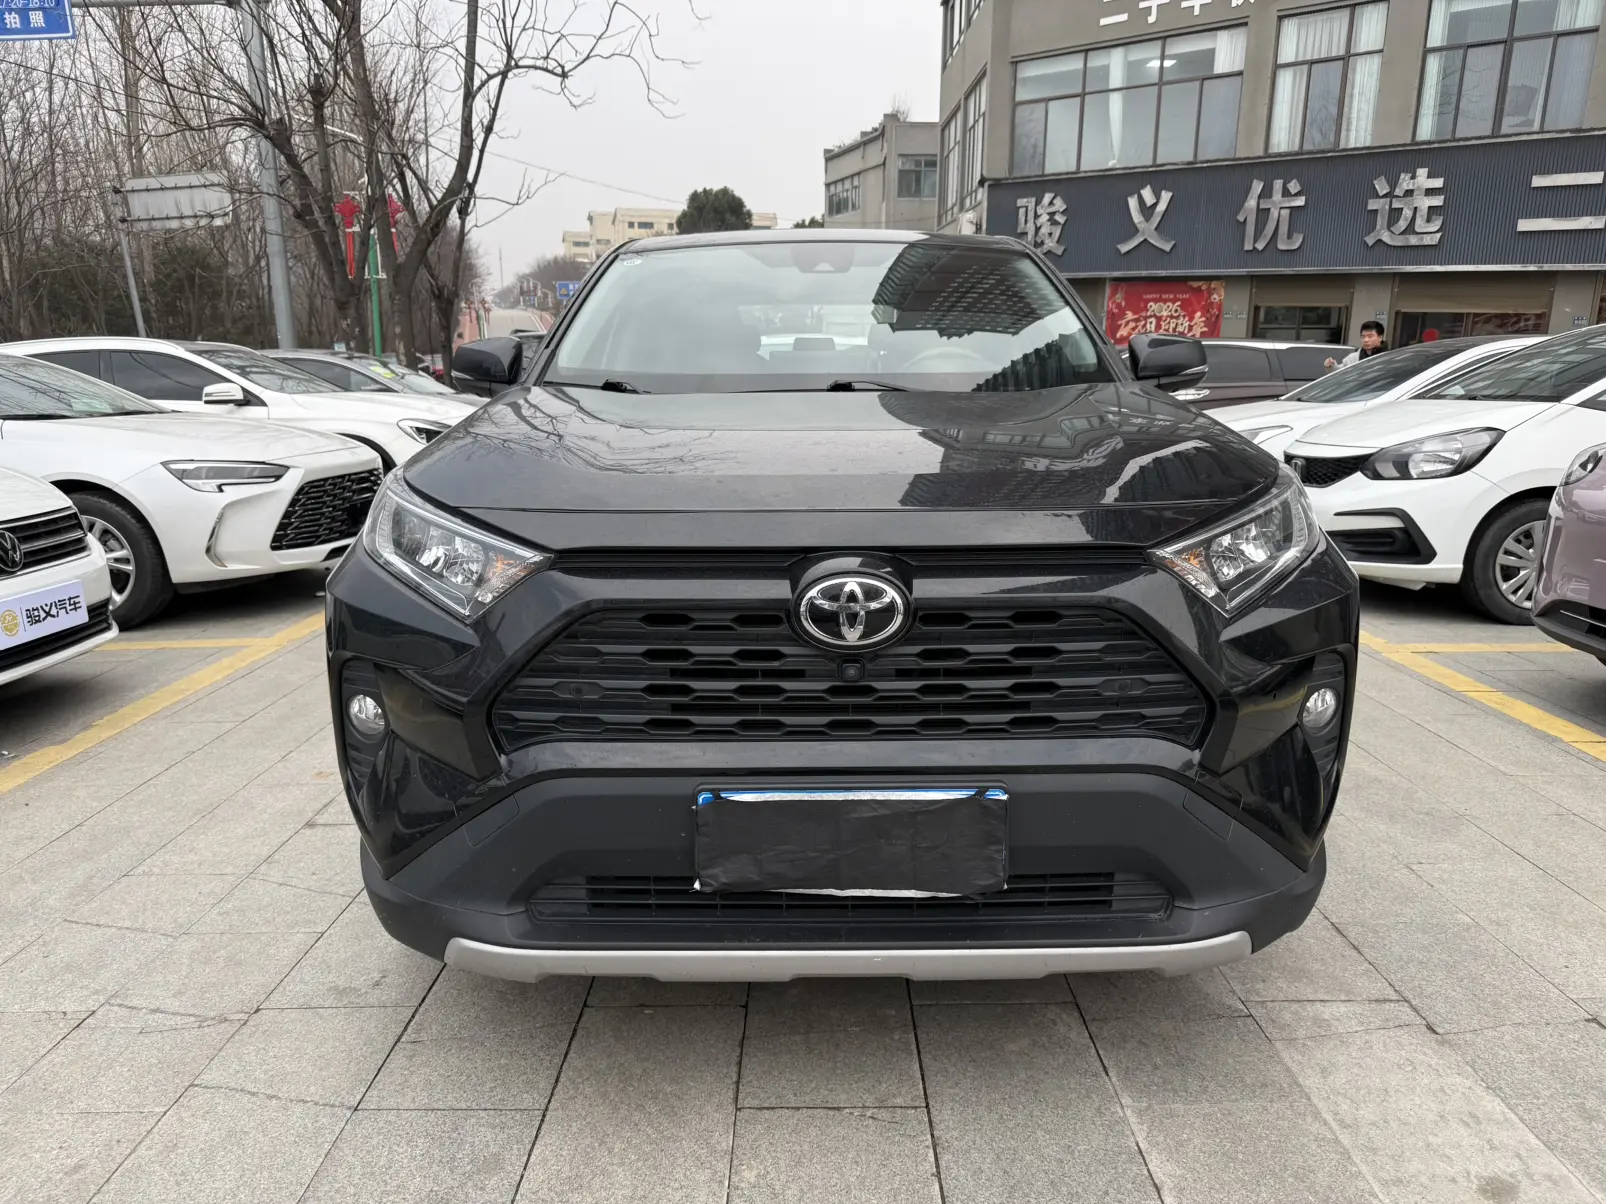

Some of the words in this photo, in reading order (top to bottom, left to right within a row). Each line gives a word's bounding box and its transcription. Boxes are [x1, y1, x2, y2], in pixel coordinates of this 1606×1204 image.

[3, 10, 47, 29] 拍照
[1147, 301, 1181, 316] 2026
[25, 594, 83, 627] 骏义汽车
